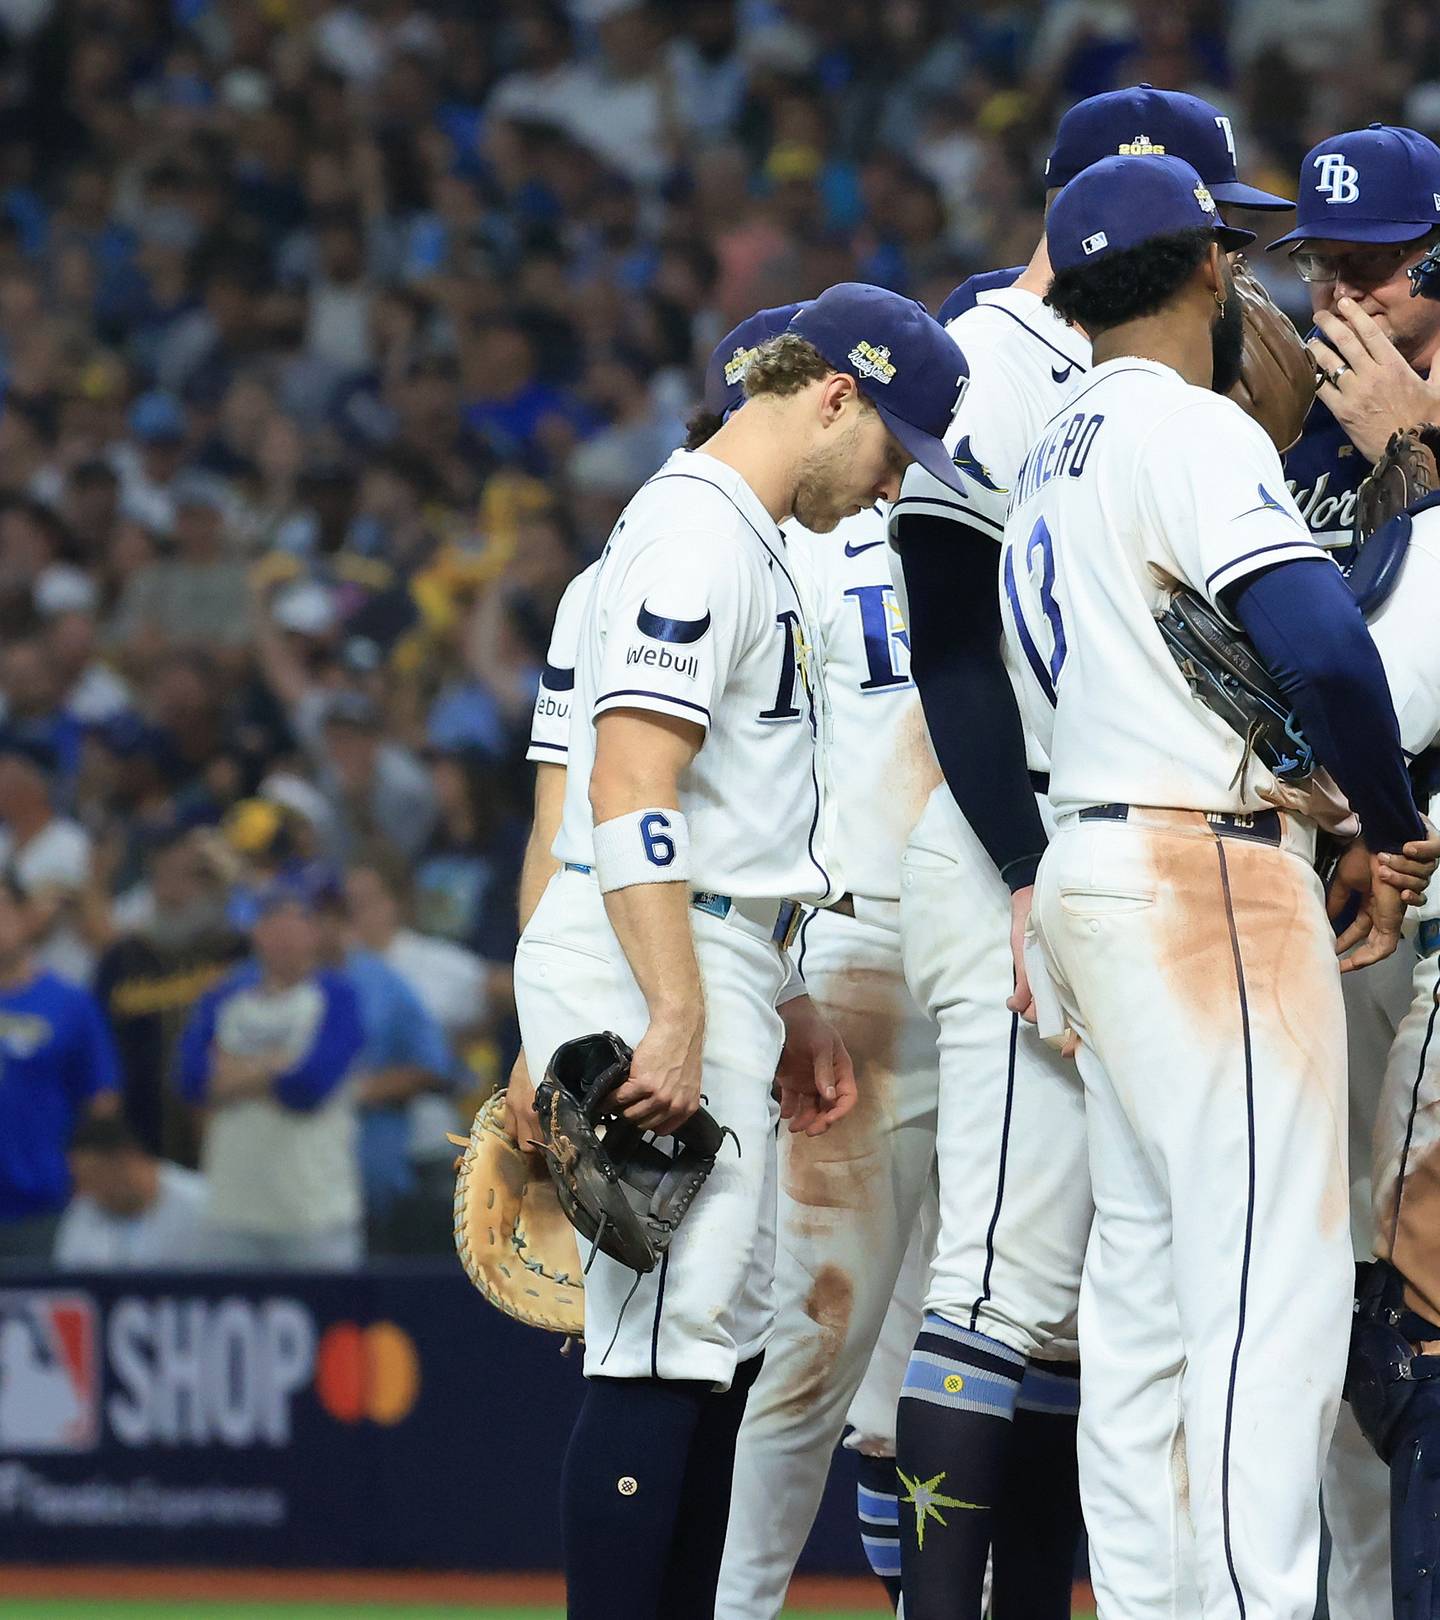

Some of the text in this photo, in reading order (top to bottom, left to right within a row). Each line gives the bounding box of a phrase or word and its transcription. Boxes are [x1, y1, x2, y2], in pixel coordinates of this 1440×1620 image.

[1313, 154, 1359, 204] TB
[1004, 515, 1067, 710] 13
[626, 645, 698, 679] Webull
[639, 810, 677, 867] 6
[106, 1296, 315, 1448] SHOP
